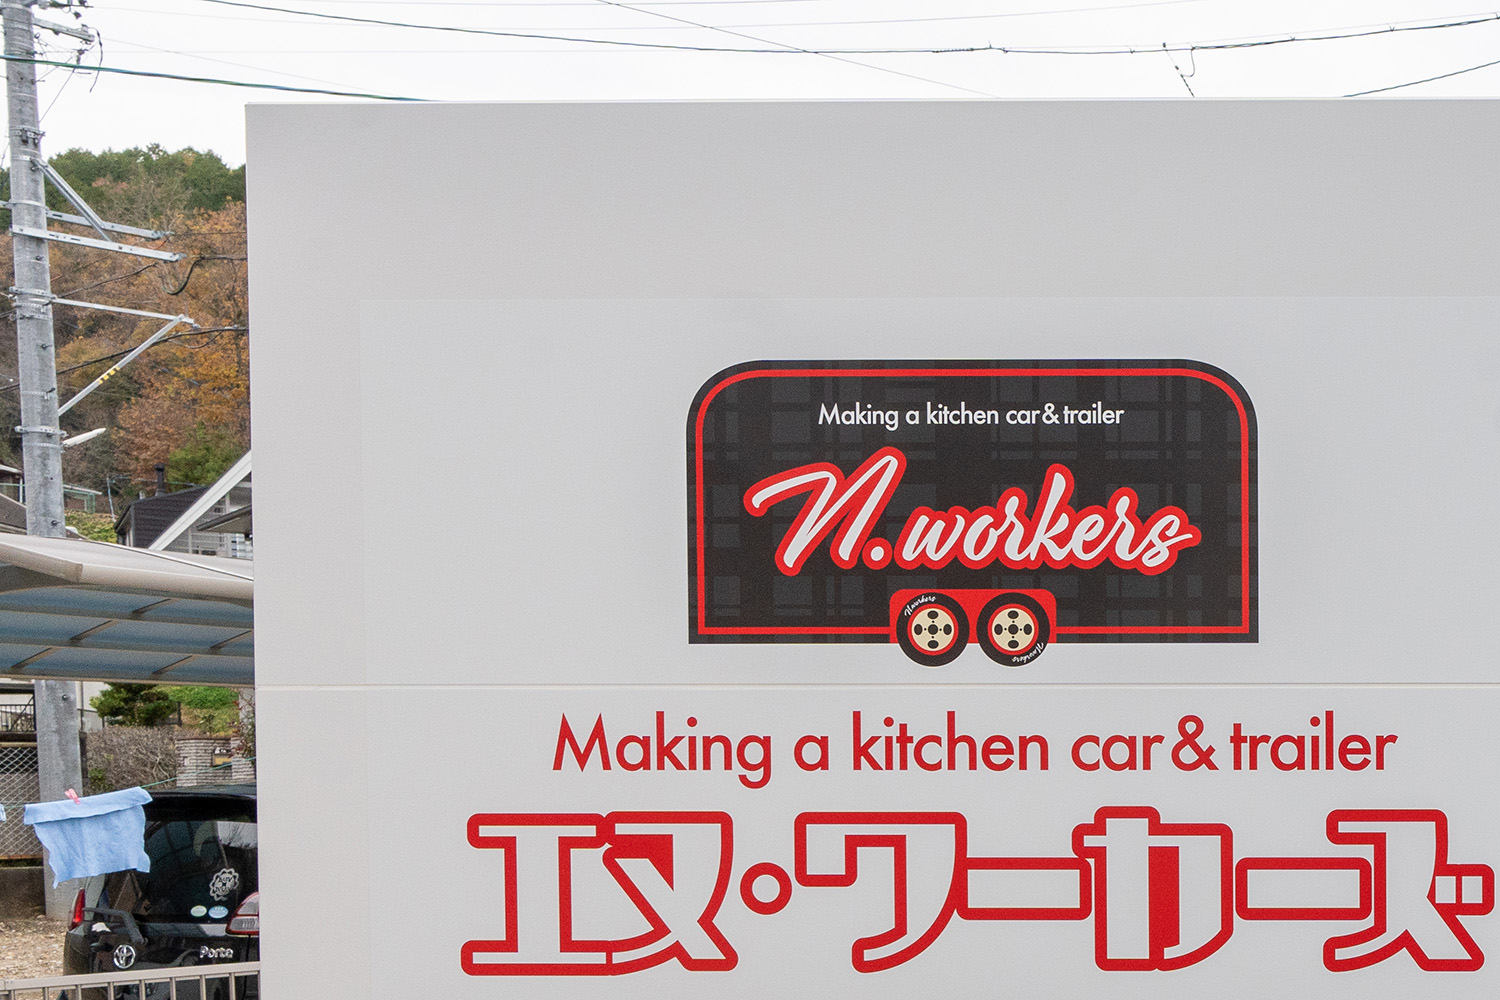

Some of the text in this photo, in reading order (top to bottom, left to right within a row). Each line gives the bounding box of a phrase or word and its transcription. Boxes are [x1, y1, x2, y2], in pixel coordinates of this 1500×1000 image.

[818, 401, 899, 432] Making
[905, 410, 920, 425] a
[926, 401, 999, 425] kitchen
[743, 446, 1202, 576] N.workers
[553, 710, 772, 790] Making
[793, 734, 830, 772] a
[852, 710, 1049, 772] kitchen
[200, 945, 234, 959] Porte
